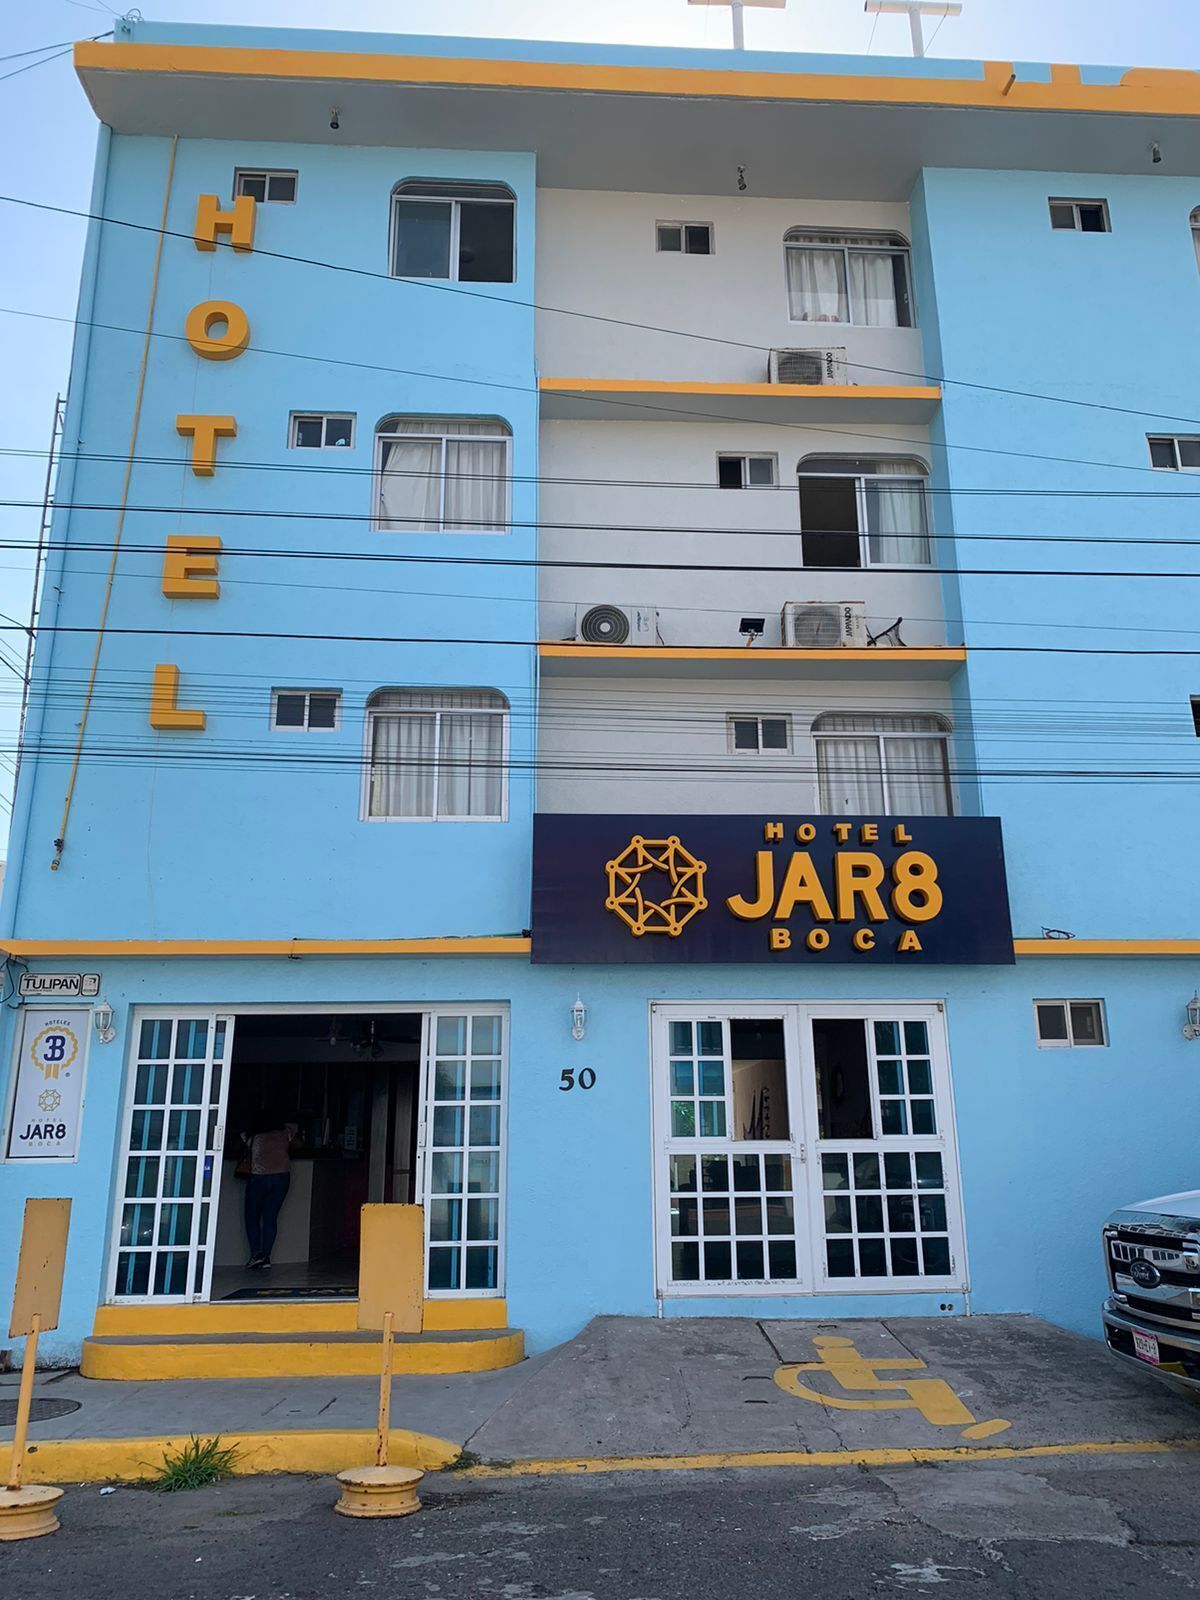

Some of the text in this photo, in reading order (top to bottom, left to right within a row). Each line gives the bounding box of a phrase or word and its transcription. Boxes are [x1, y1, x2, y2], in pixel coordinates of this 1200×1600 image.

[150, 193, 256, 730] HOTEL
[765, 822, 913, 844] HOTEL
[727, 850, 943, 922] JAR8
[770, 928, 923, 952] BOCA
[23, 978, 79, 990] TULIPAN
[559, 1067, 597, 1091] 50
[19, 1123, 66, 1140] JAR8
